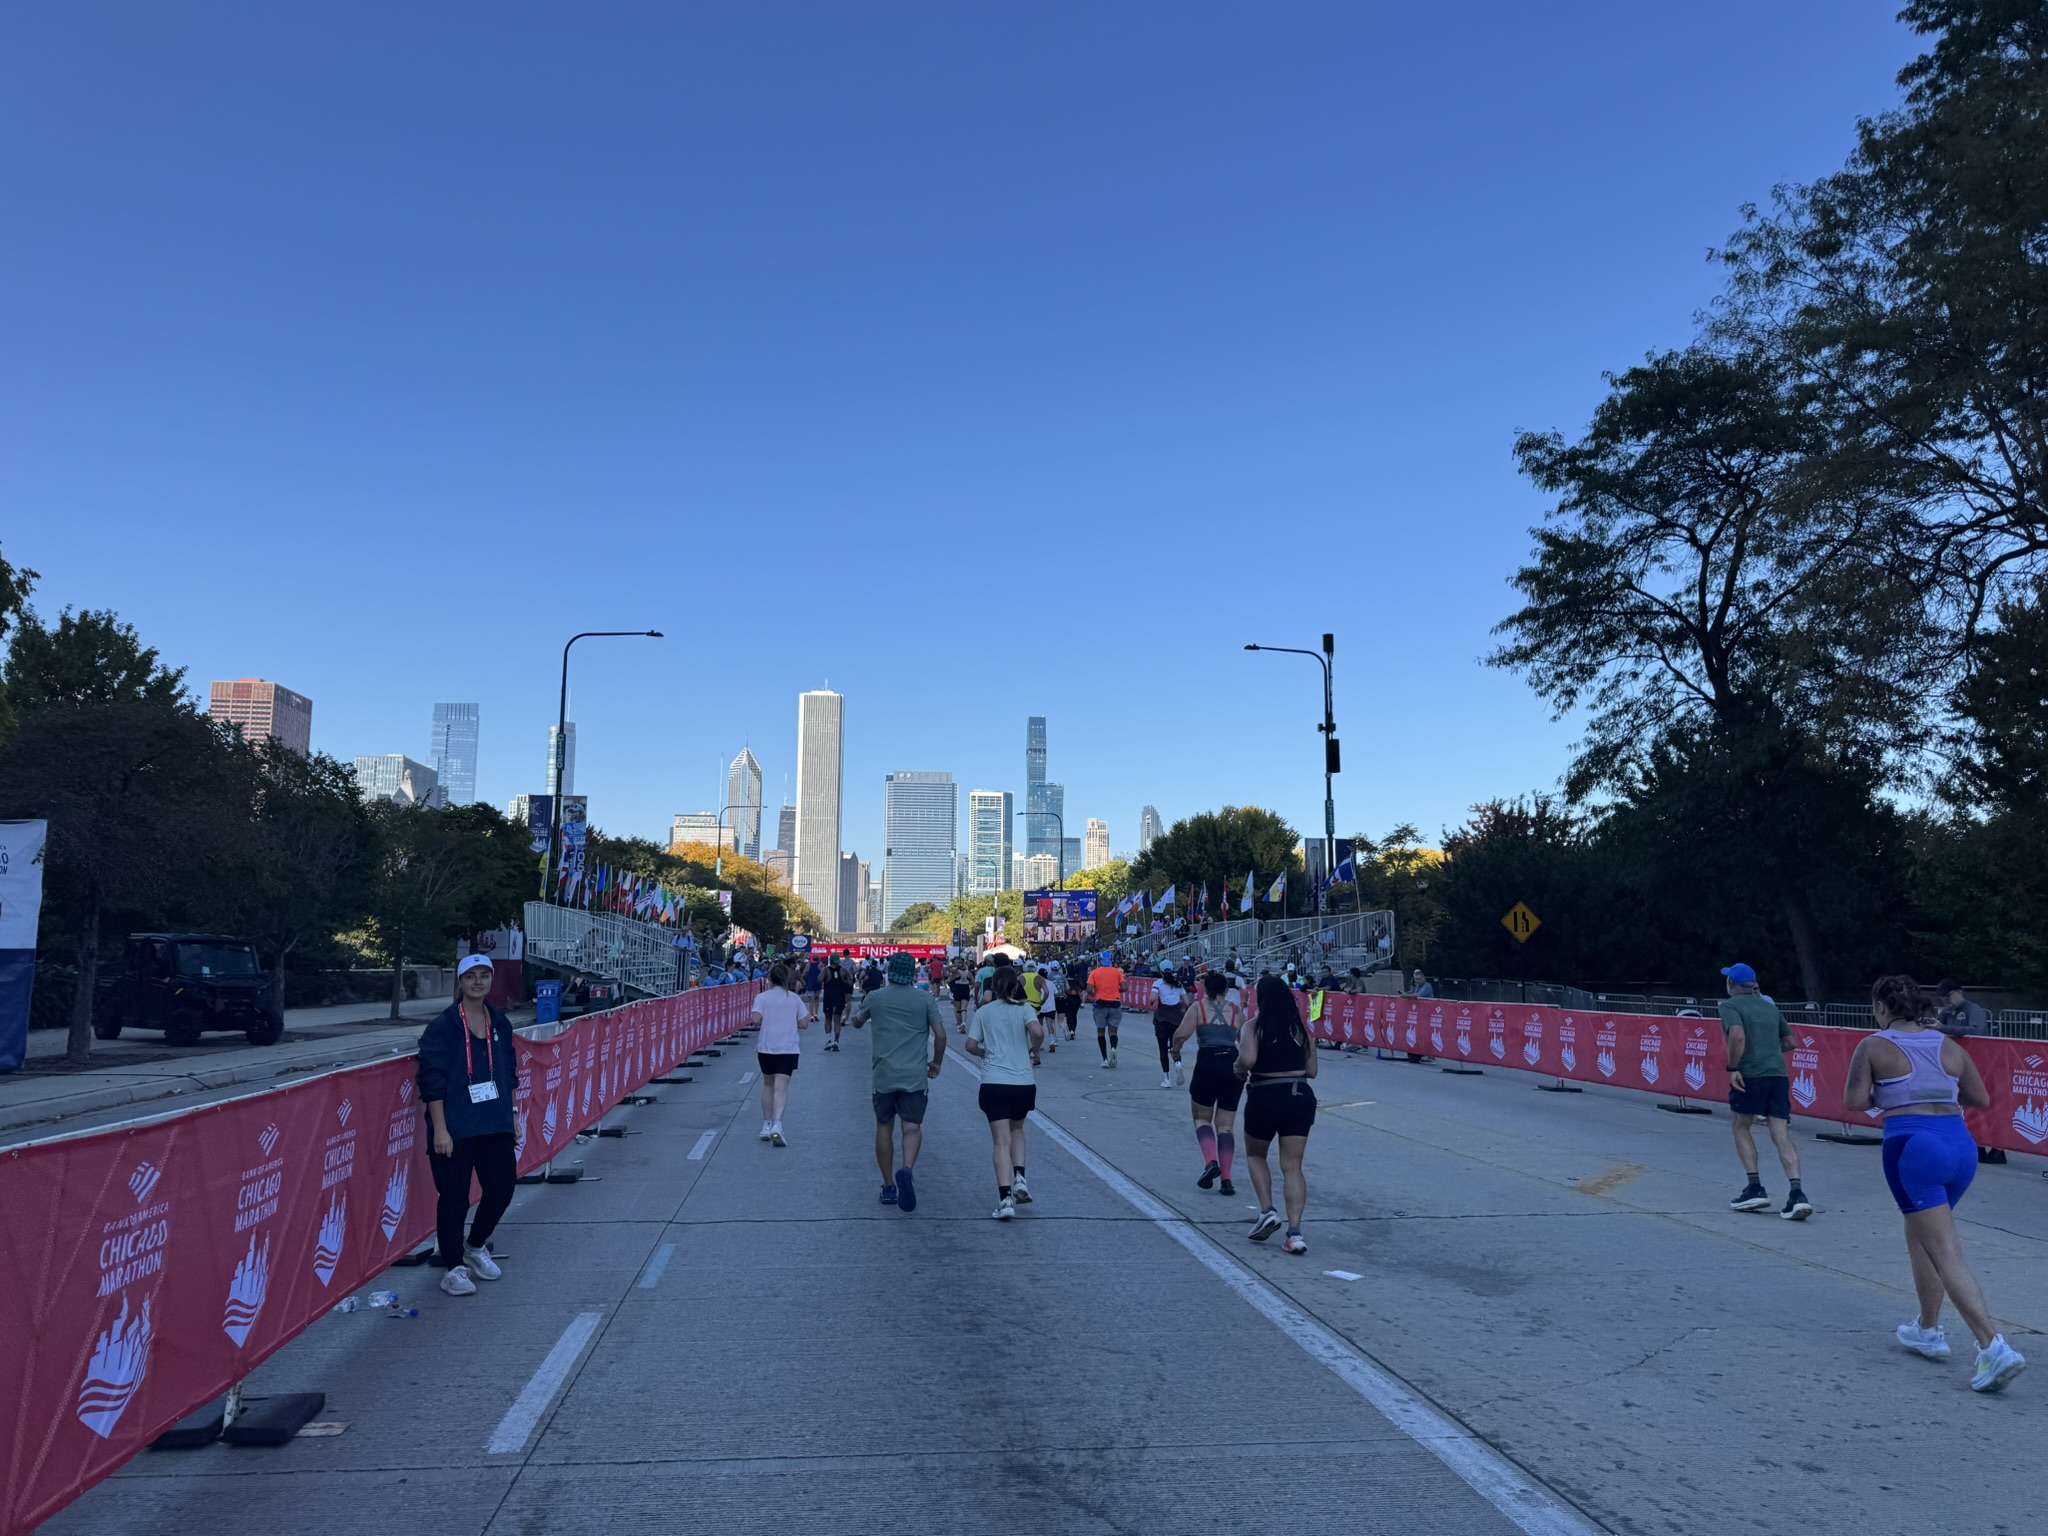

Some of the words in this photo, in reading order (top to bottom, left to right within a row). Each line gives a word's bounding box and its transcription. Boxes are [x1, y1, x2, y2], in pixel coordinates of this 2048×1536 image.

[859, 946, 899, 956] FINISH
[1597, 1033, 1617, 1042] CHICAGO
[1685, 1041, 1708, 1051] CHICAGO
[1792, 1052, 1819, 1063] CHICAGO
[2012, 1074, 2048, 1088] CHICAG
[2012, 1085, 2048, 1097] MARATHO
[389, 1116, 416, 1141] CHICAGO
[324, 1140, 355, 1171] CHICAGO
[387, 1135, 414, 1157] MARATHON
[241, 1168, 257, 1181] BANK
[321, 1162, 353, 1191] MARATHON
[237, 1171, 282, 1210] CHICAGO
[103, 1217, 129, 1233] BANK
[129, 1213, 138, 1226] OF
[136, 1201, 169, 1222] AMERICA
[234, 1196, 279, 1233] MARATHON
[100, 1219, 168, 1269] CHICAGO
[96, 1249, 163, 1298] MARATHON
